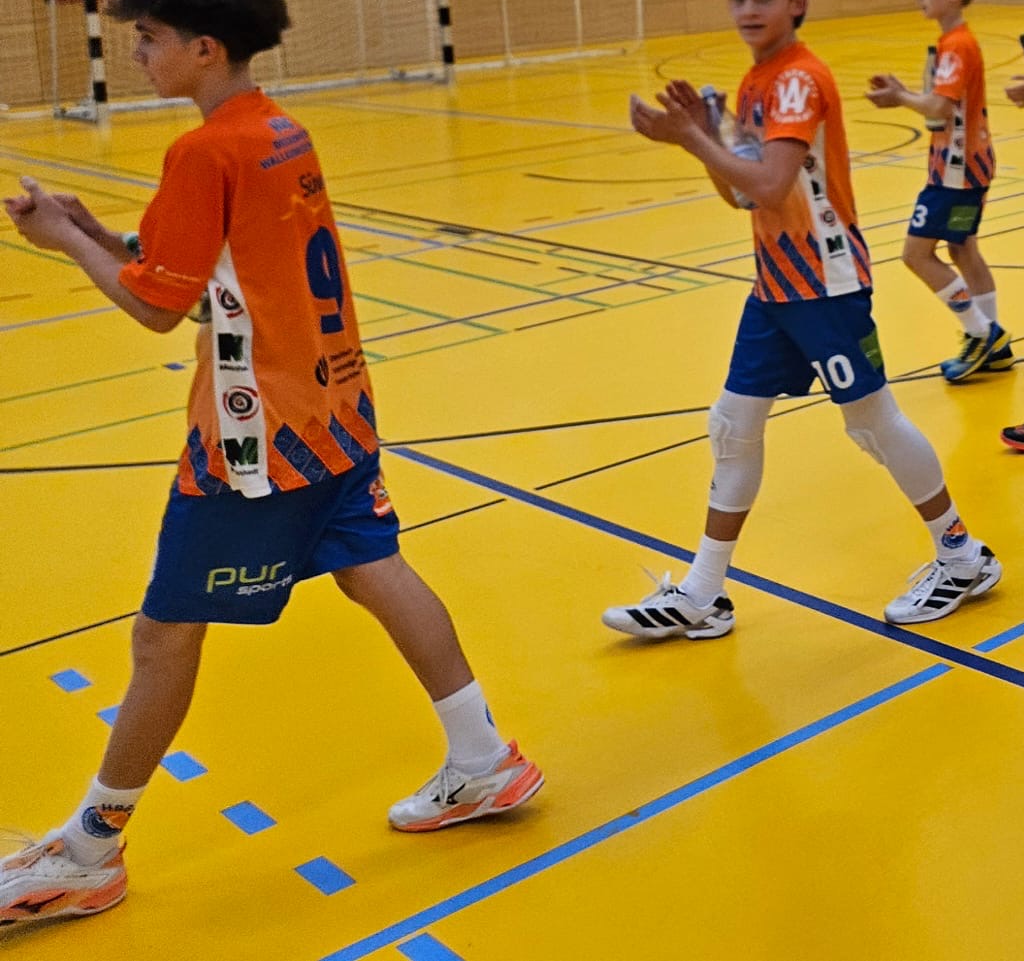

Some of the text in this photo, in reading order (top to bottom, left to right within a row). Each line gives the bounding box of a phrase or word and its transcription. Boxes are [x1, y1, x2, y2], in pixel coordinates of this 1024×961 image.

[911, 205, 928, 228] 3
[306, 227, 345, 334] 9
[811, 354, 856, 390] 10
[223, 436, 259, 466] M
[206, 561, 287, 593] pur
